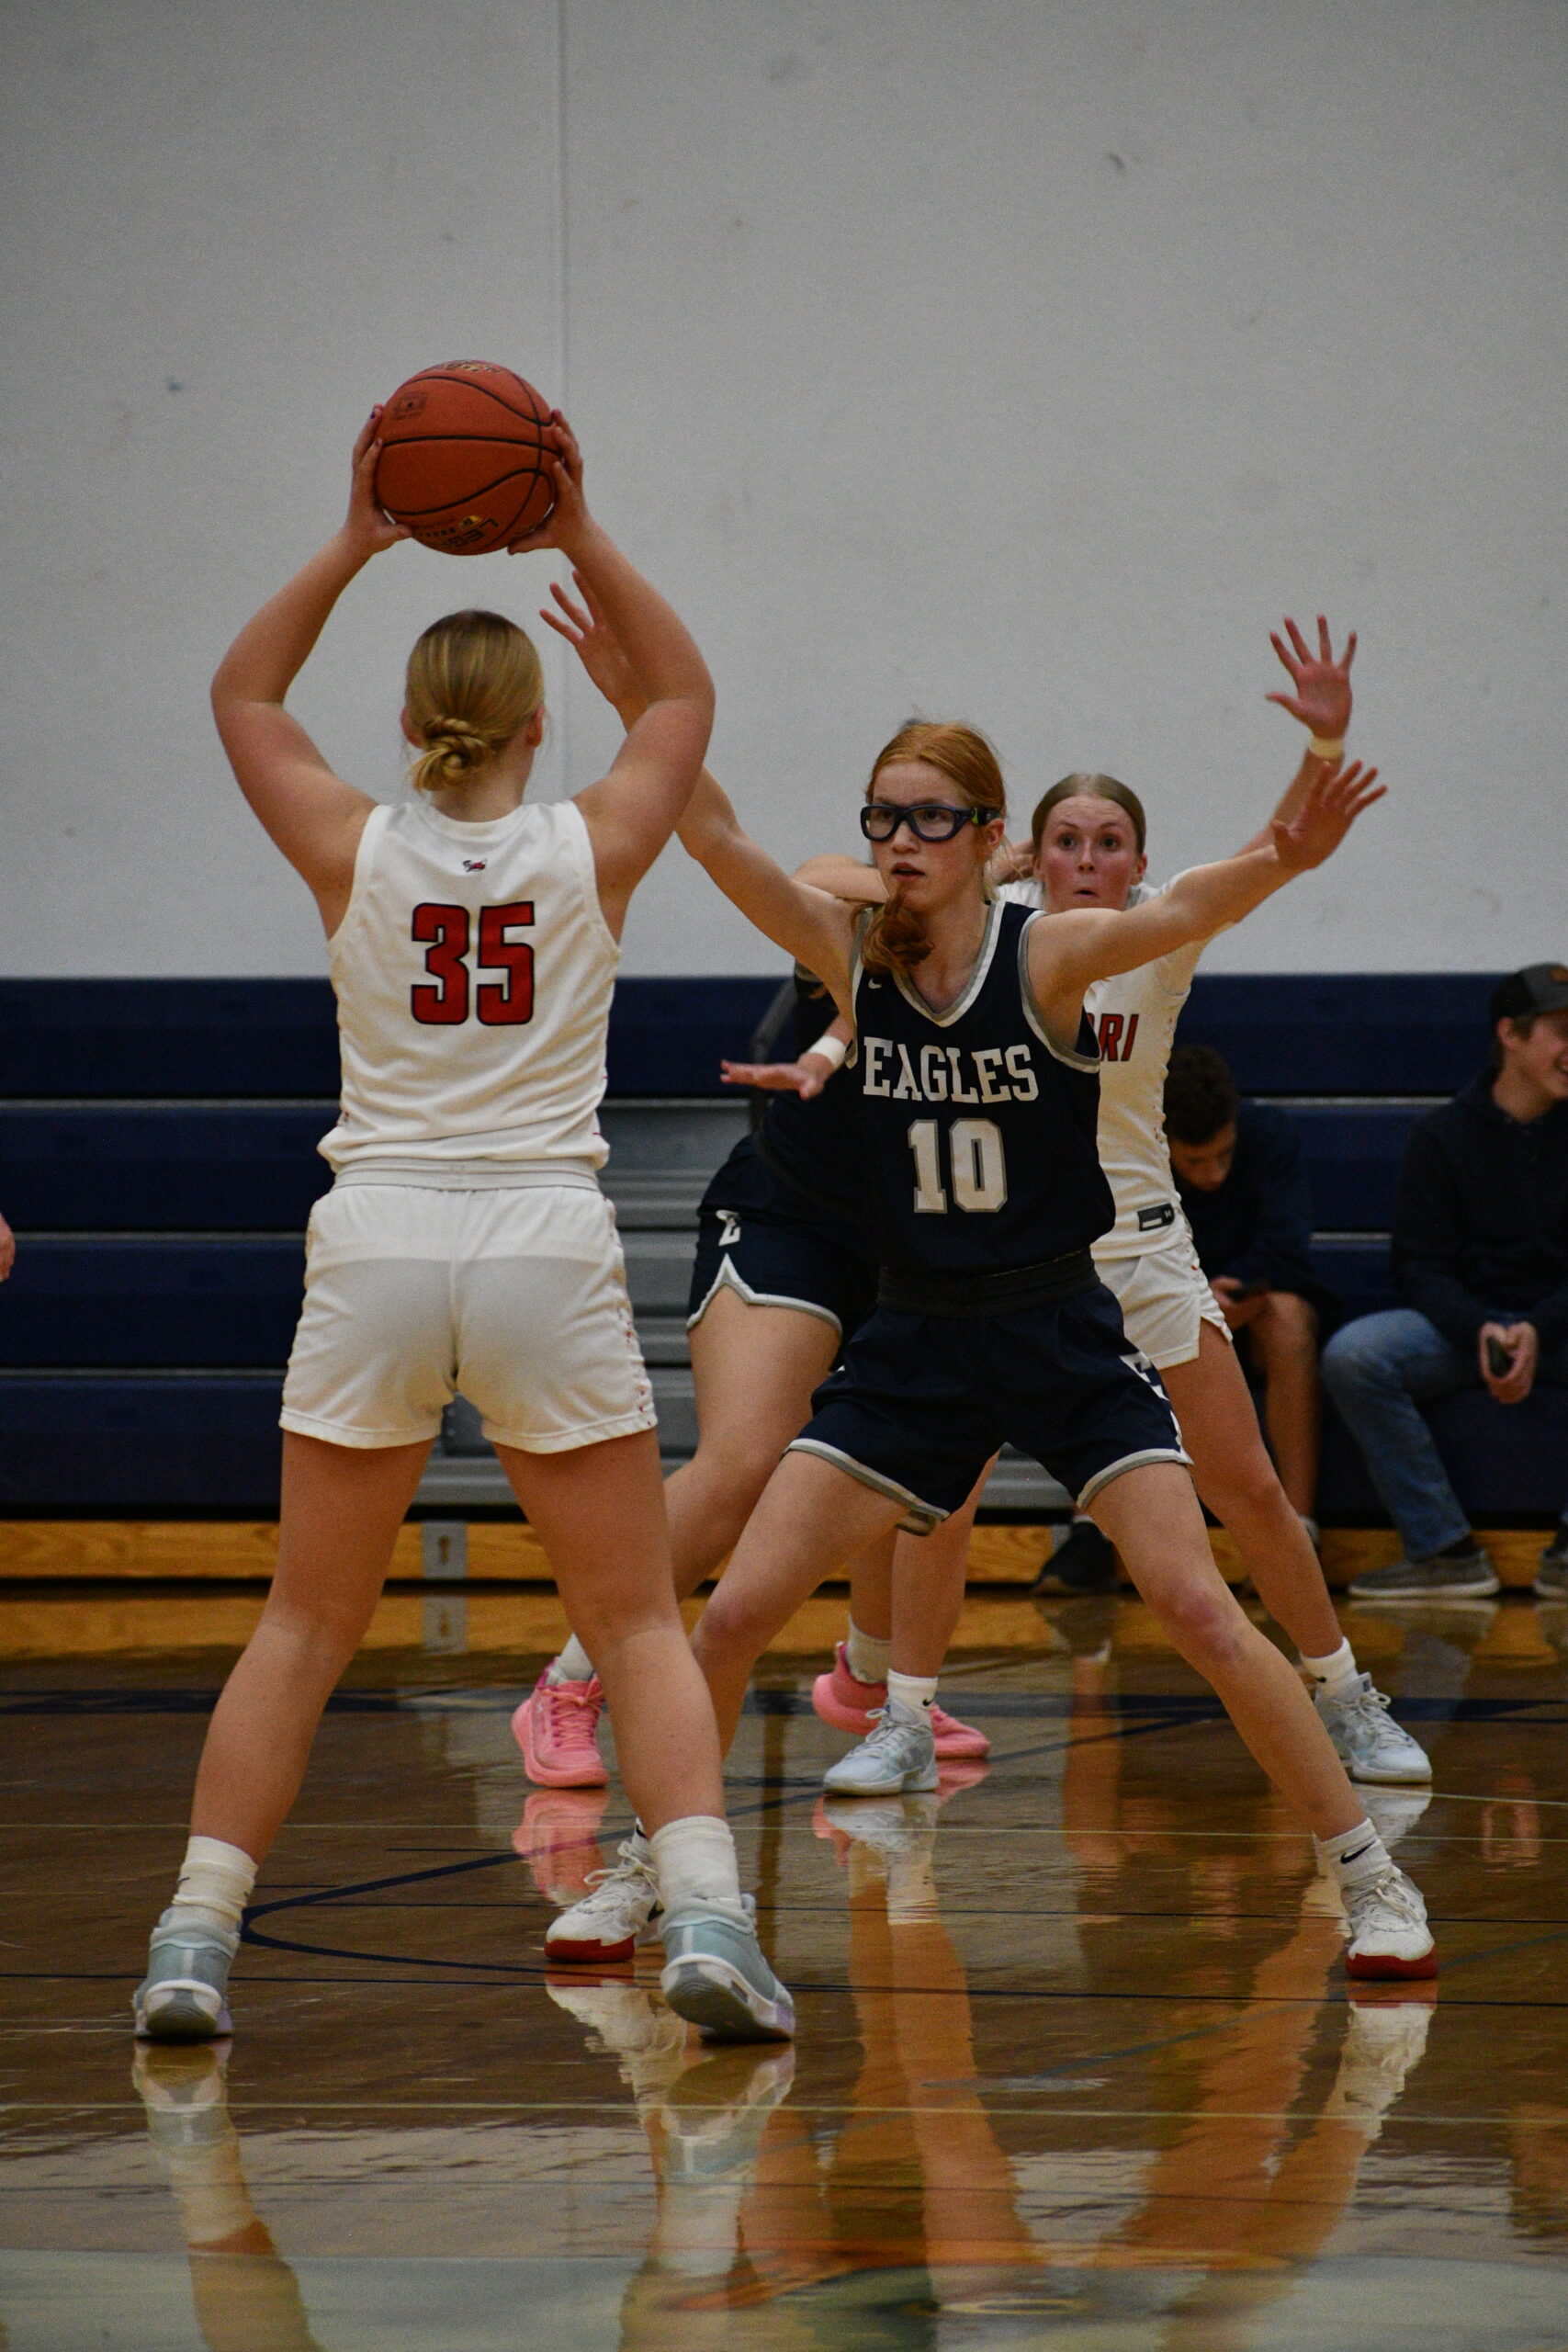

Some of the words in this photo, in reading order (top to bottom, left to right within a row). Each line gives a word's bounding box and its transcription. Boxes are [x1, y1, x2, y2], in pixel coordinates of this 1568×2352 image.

[411, 901, 535, 1025] 35
[863, 1035, 1040, 1103] EAGLES
[1087, 1012, 1139, 1062] RI
[907, 1117, 1009, 1215] 10
